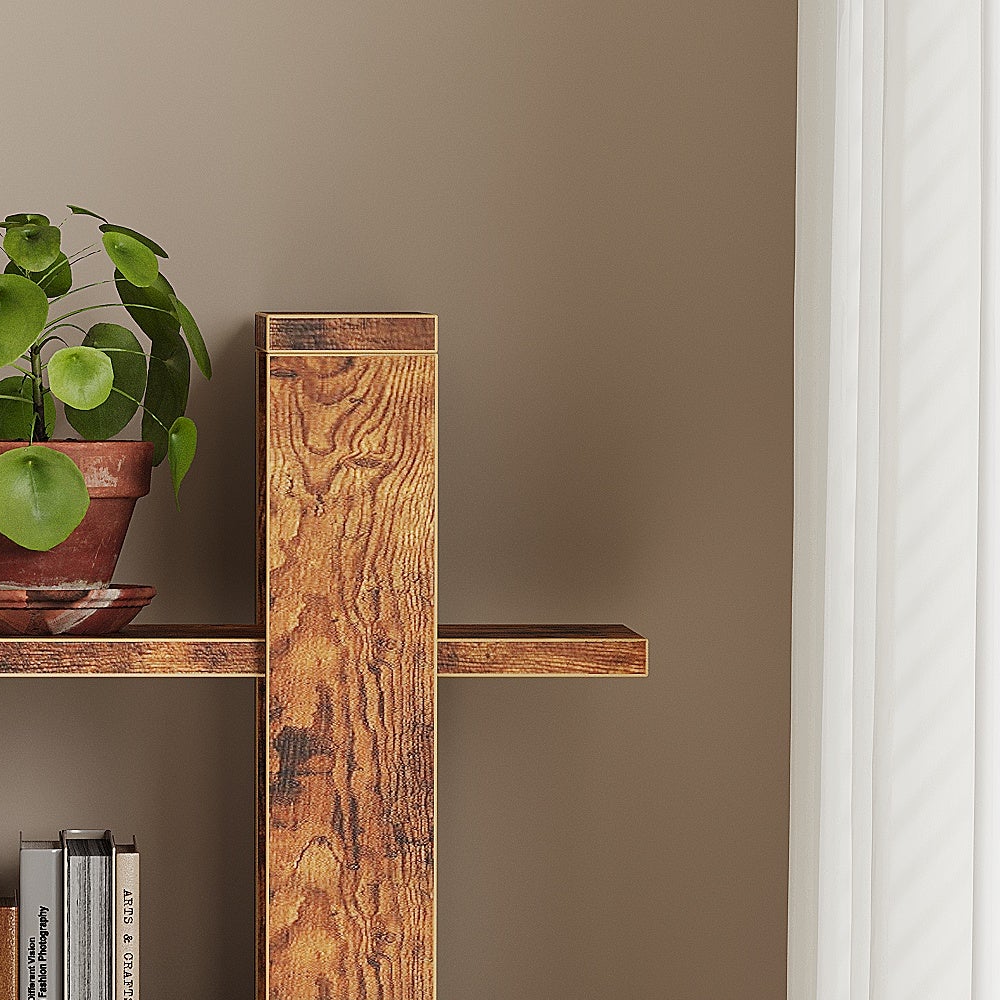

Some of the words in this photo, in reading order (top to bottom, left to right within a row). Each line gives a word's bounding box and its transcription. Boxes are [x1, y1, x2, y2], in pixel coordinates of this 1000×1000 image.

[124, 888, 134, 925] ARTS
[28, 936, 36, 965] Vision
[38, 905, 50, 962] Photography
[124, 933, 133, 944] &
[38, 963, 48, 998] Fashion
